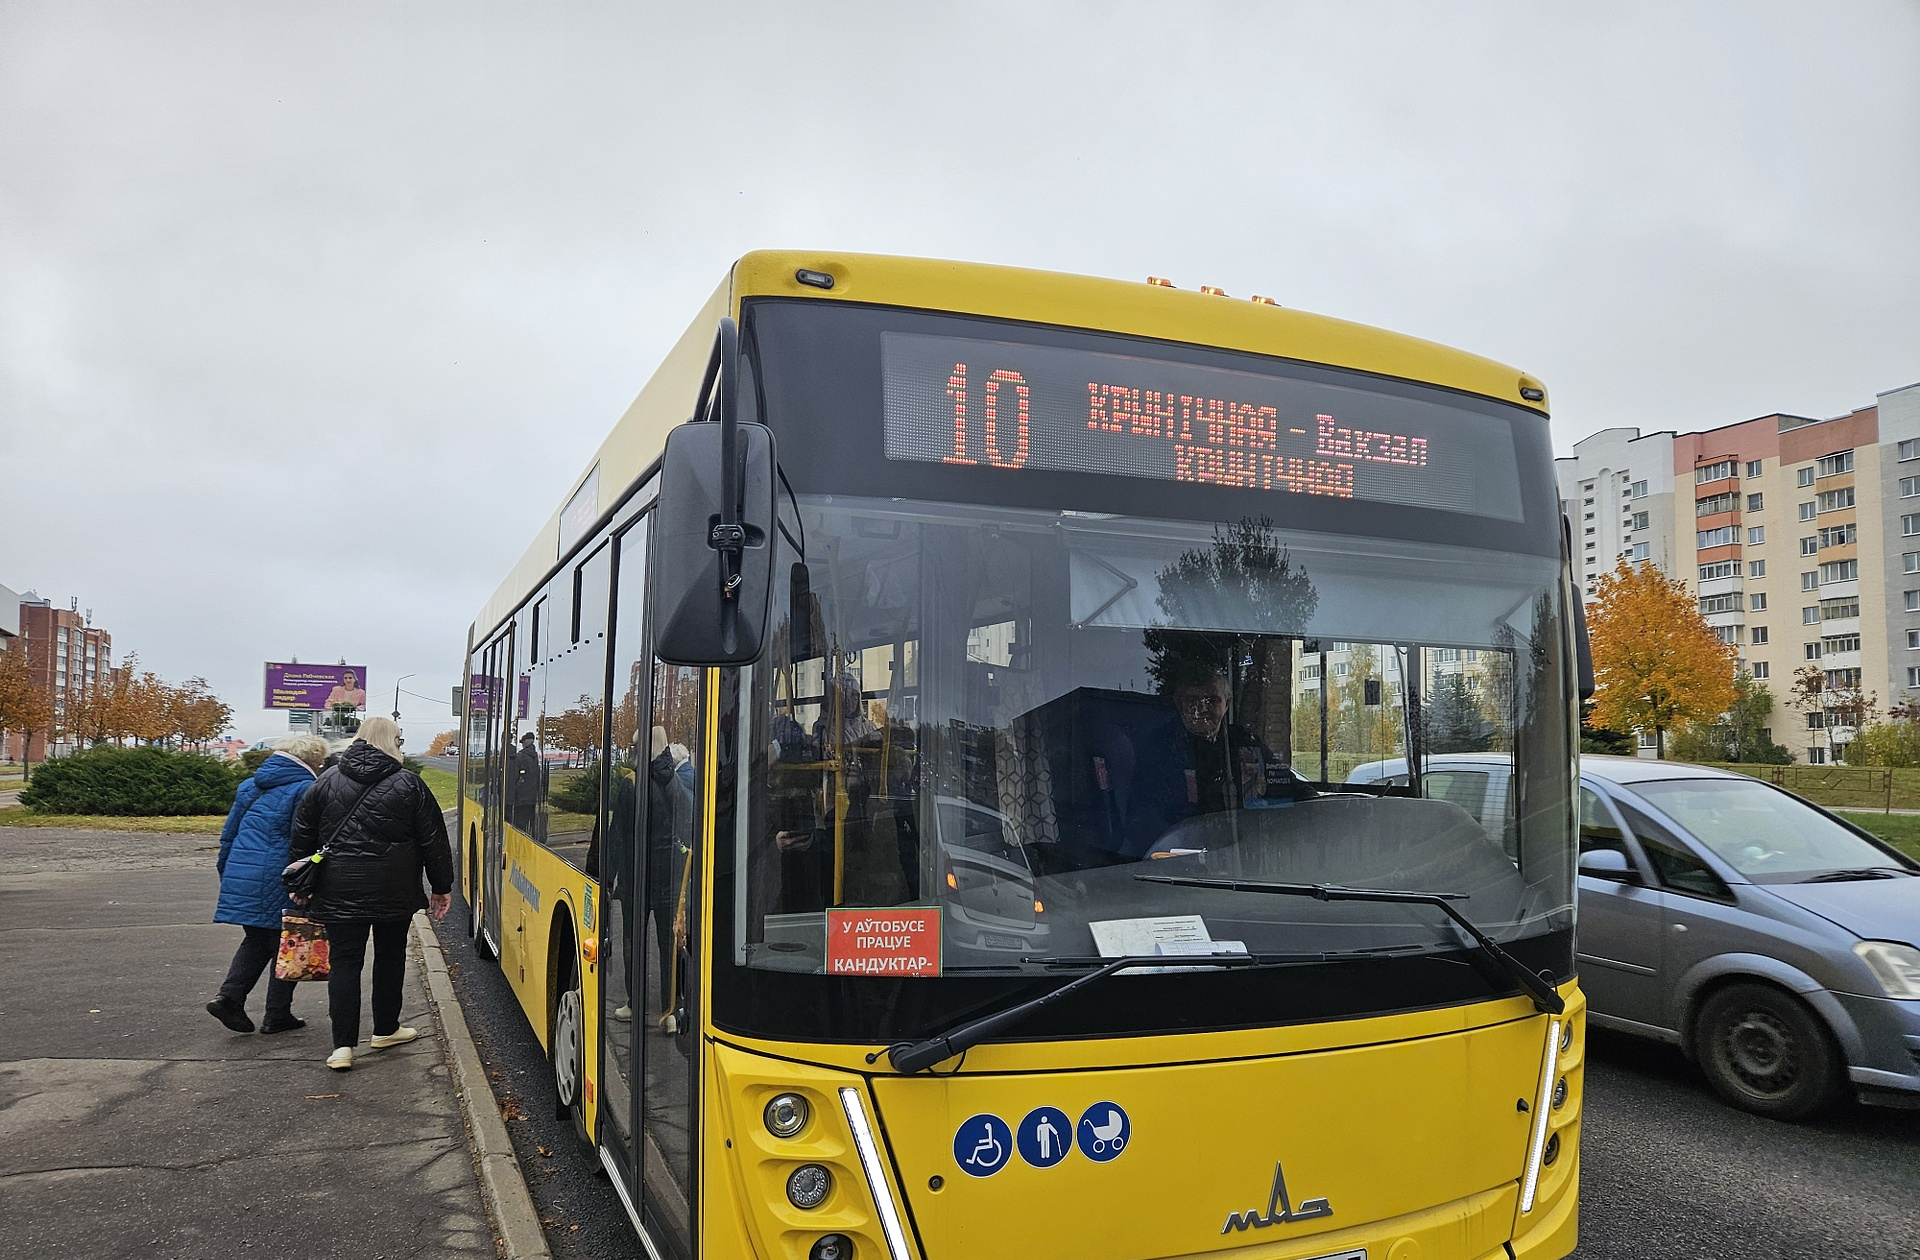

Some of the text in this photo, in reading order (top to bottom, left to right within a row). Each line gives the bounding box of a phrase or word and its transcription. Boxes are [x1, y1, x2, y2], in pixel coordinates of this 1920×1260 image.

[942, 363, 1029, 469] 10
[1088, 382, 1276, 450] КРЫНІЧНАЯ
[1316, 413, 1428, 467] Вакзал
[842, 918, 925, 934] У АЎТОБУСЕ
[856, 936, 912, 951] ПРАЦУЕ
[834, 957, 933, 974] КАНДУКТАР-
